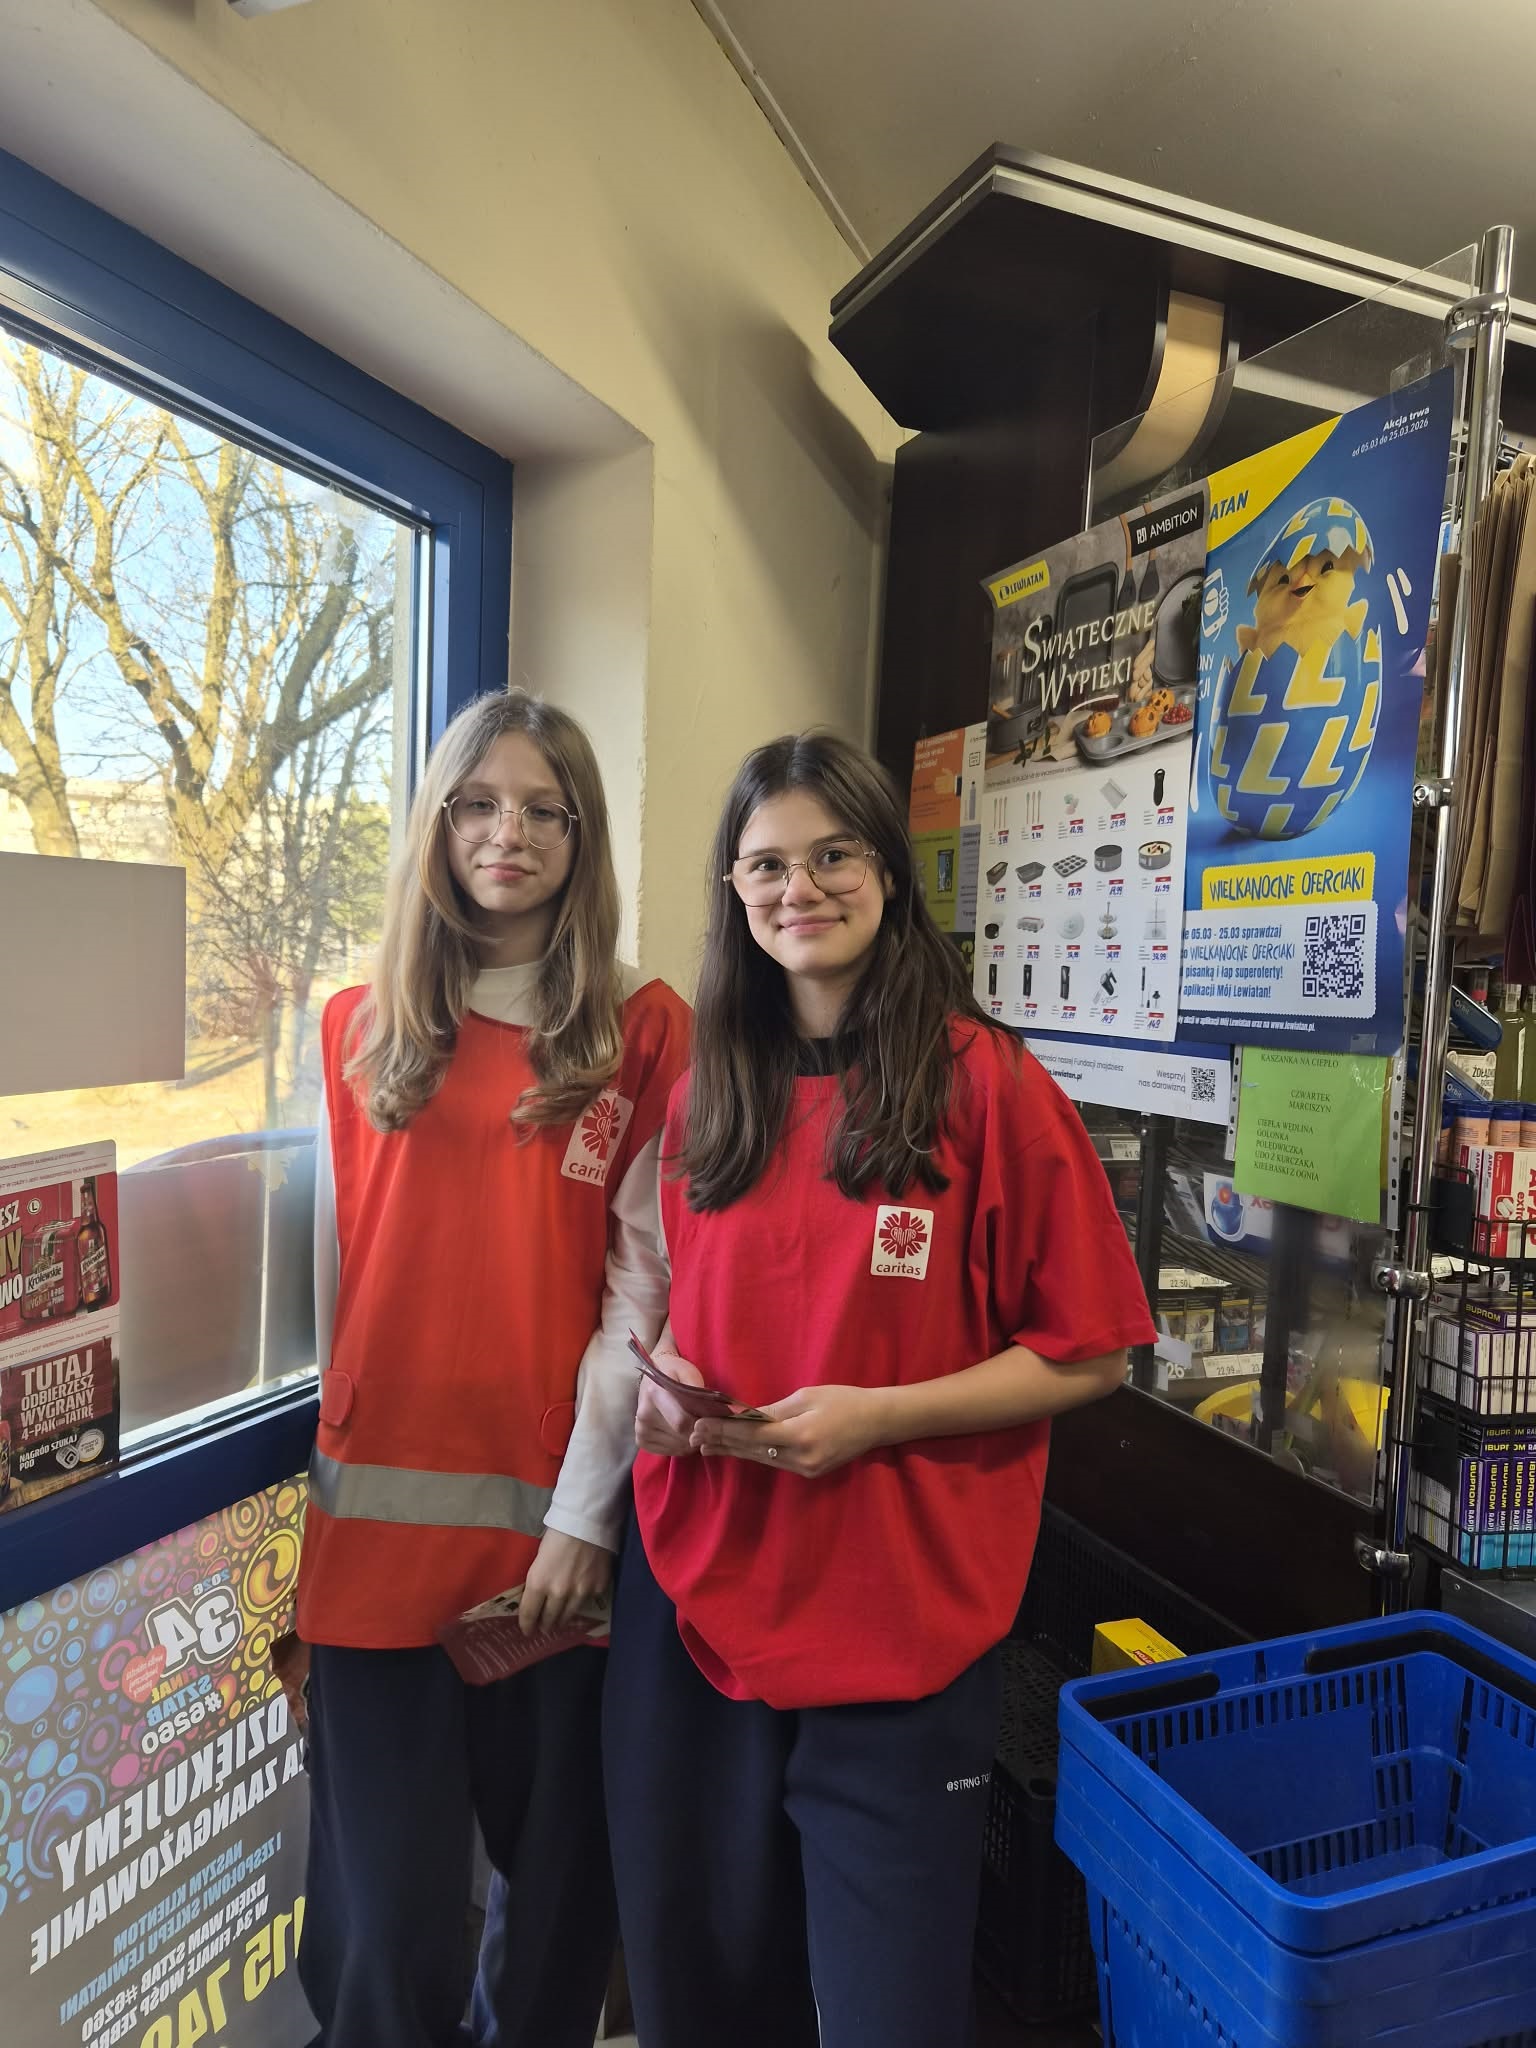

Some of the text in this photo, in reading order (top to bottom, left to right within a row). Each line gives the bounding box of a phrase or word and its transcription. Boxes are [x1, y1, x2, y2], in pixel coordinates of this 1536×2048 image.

[1383, 406, 1430, 431] Akcja trwa
[1352, 418, 1429, 457] od 05.03 do 25.03.2026
[1209, 489, 1249, 523] ATAN
[1150, 507, 1198, 538] AMBITION
[1010, 571, 1044, 595] LEWIATAN
[1022, 600, 1156, 673] ŚWIĄTECZNE
[1038, 657, 1132, 713] WYPIEKI
[1209, 866, 1365, 902] WIELKANOCNE OFERCIAKI
[1191, 928, 1212, 940] 05.03
[1219, 927, 1240, 940] 25.03
[1242, 925, 1282, 941] sprawdzaj
[1190, 944, 1248, 962] WIELKANOCNE
[1252, 943, 1296, 961] OFERCIAKI
[1185, 965, 1215, 981] pisanką
[1221, 965, 1233, 979] łap
[1235, 965, 1283, 980] superoferty!
[1183, 984, 1271, 998] aplikacji Mój Lewiatan!
[1454, 1000, 1470, 1014] Orbit
[1261, 1054, 1298, 1065] KASZANKA
[1300, 1057, 1310, 1066] NA
[1138, 1079, 1186, 1093] nas darowizną
[1156, 1069, 1186, 1083] Wesprzyj
[1290, 1089, 1330, 1102] CZWARTEK
[1446, 1083, 1462, 1098] Orbit
[1288, 1100, 1332, 1113] MARCISZYN
[1256, 1129, 1289, 1142] GOLONKA
[1254, 1150, 1270, 1160] UDO
[1276, 1154, 1314, 1169] KURCZAKA
[1296, 1170, 1320, 1182] OGNIA
[1490, 1232, 1497, 1243] 10
[28, 1266, 62, 1292] Królewskie
[876, 1262, 921, 1276] caritas
[21, 1348, 94, 1396] TUTAJ
[1166, 1362, 1185, 1379] 26
[21, 1374, 95, 1412] ODBIERZESZ
[20, 1388, 95, 1428] WYGRANY
[21, 1417, 56, 1441] 4-PAK
[64, 1404, 94, 1425] TATRĘ
[19, 1445, 50, 1464] NAGRÓD
[50, 1434, 78, 1451] SZUKAJ
[19, 1458, 35, 1472] POD
[1468, 1462, 1477, 1507] IBUPROM
[1488, 1464, 1498, 1510] IBUPROM
[1514, 1462, 1524, 1507] IBUPROM
[1526, 1460, 1536, 1506] IBUPROM
